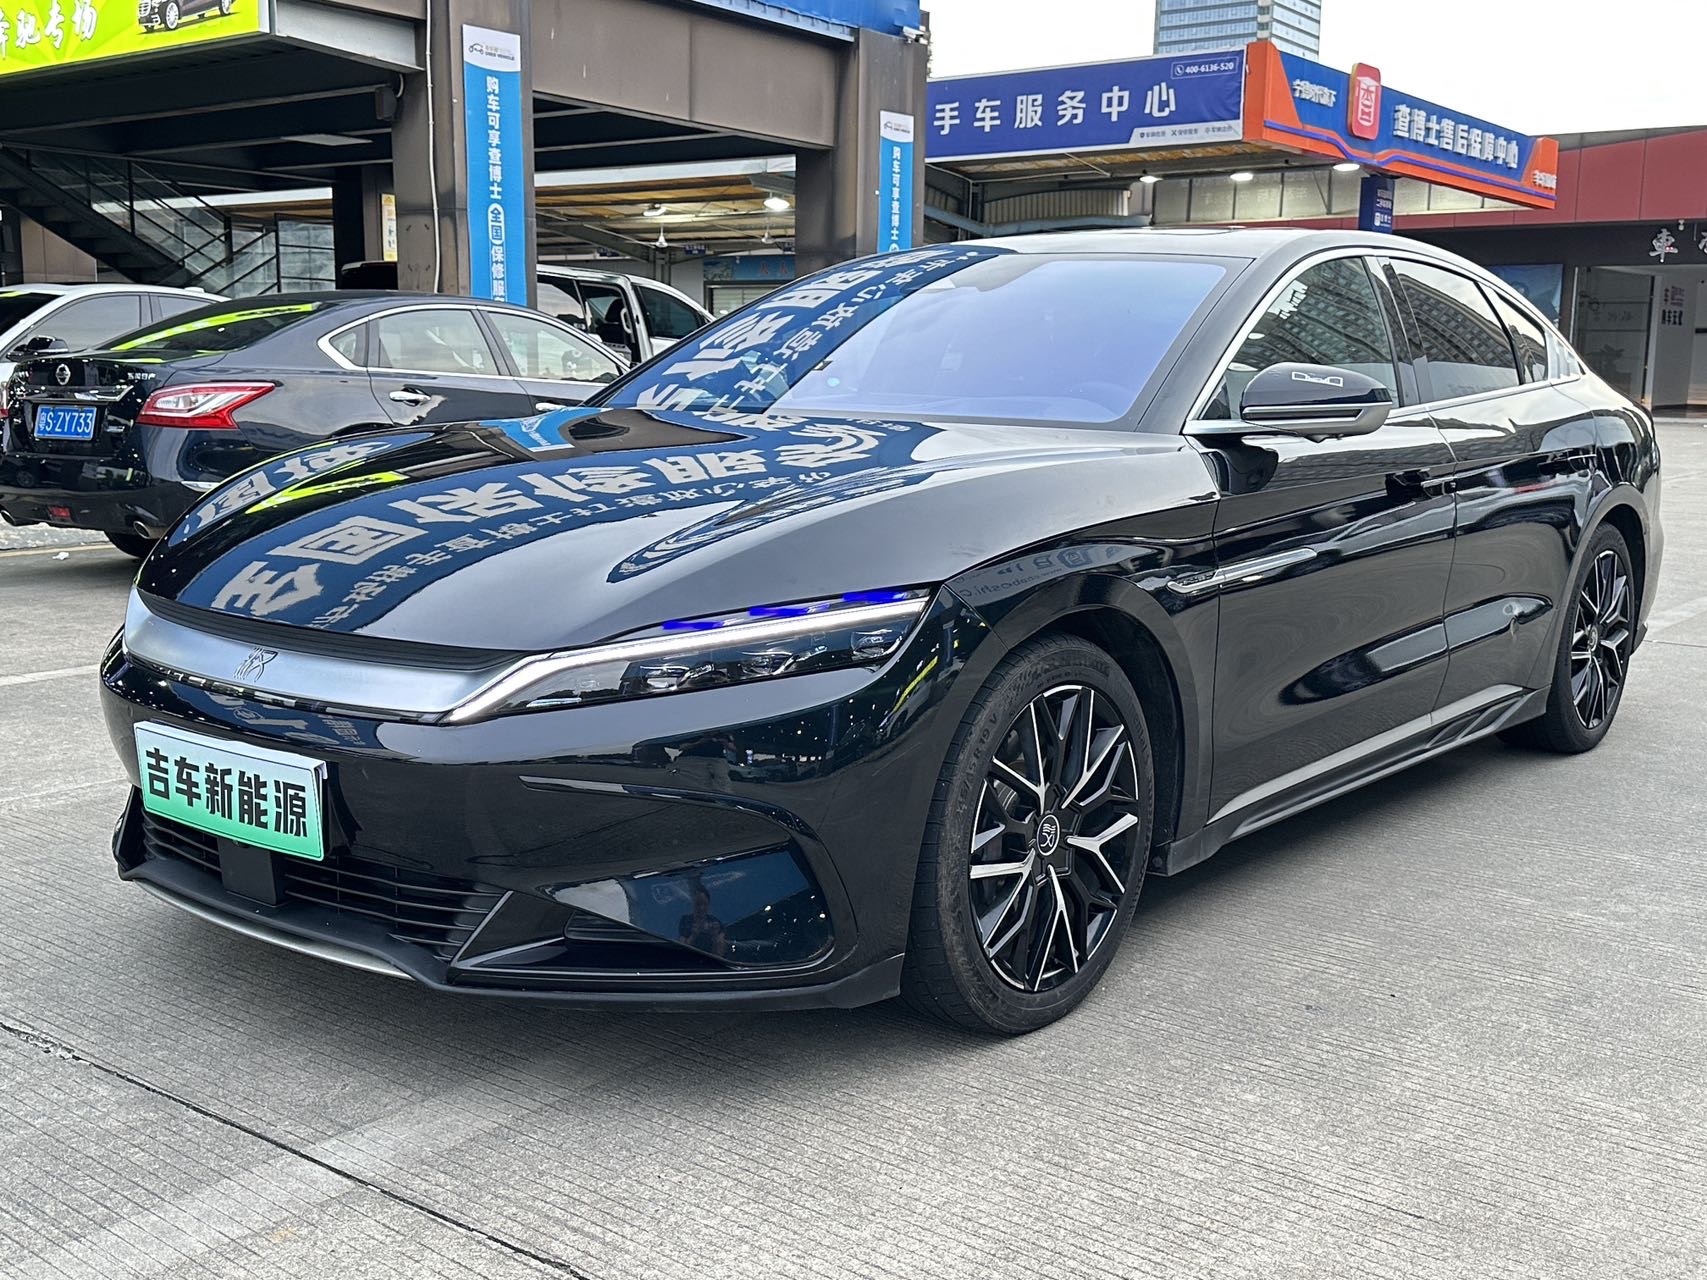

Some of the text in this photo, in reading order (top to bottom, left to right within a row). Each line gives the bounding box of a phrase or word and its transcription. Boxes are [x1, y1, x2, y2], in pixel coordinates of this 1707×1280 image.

[1184, 62, 1234, 75] 400-6136-520
[933, 82, 1177, 136] 手车服务中心
[1393, 103, 1519, 169] 查博士售后保障中心
[146, 747, 308, 838] 吉车新能源
